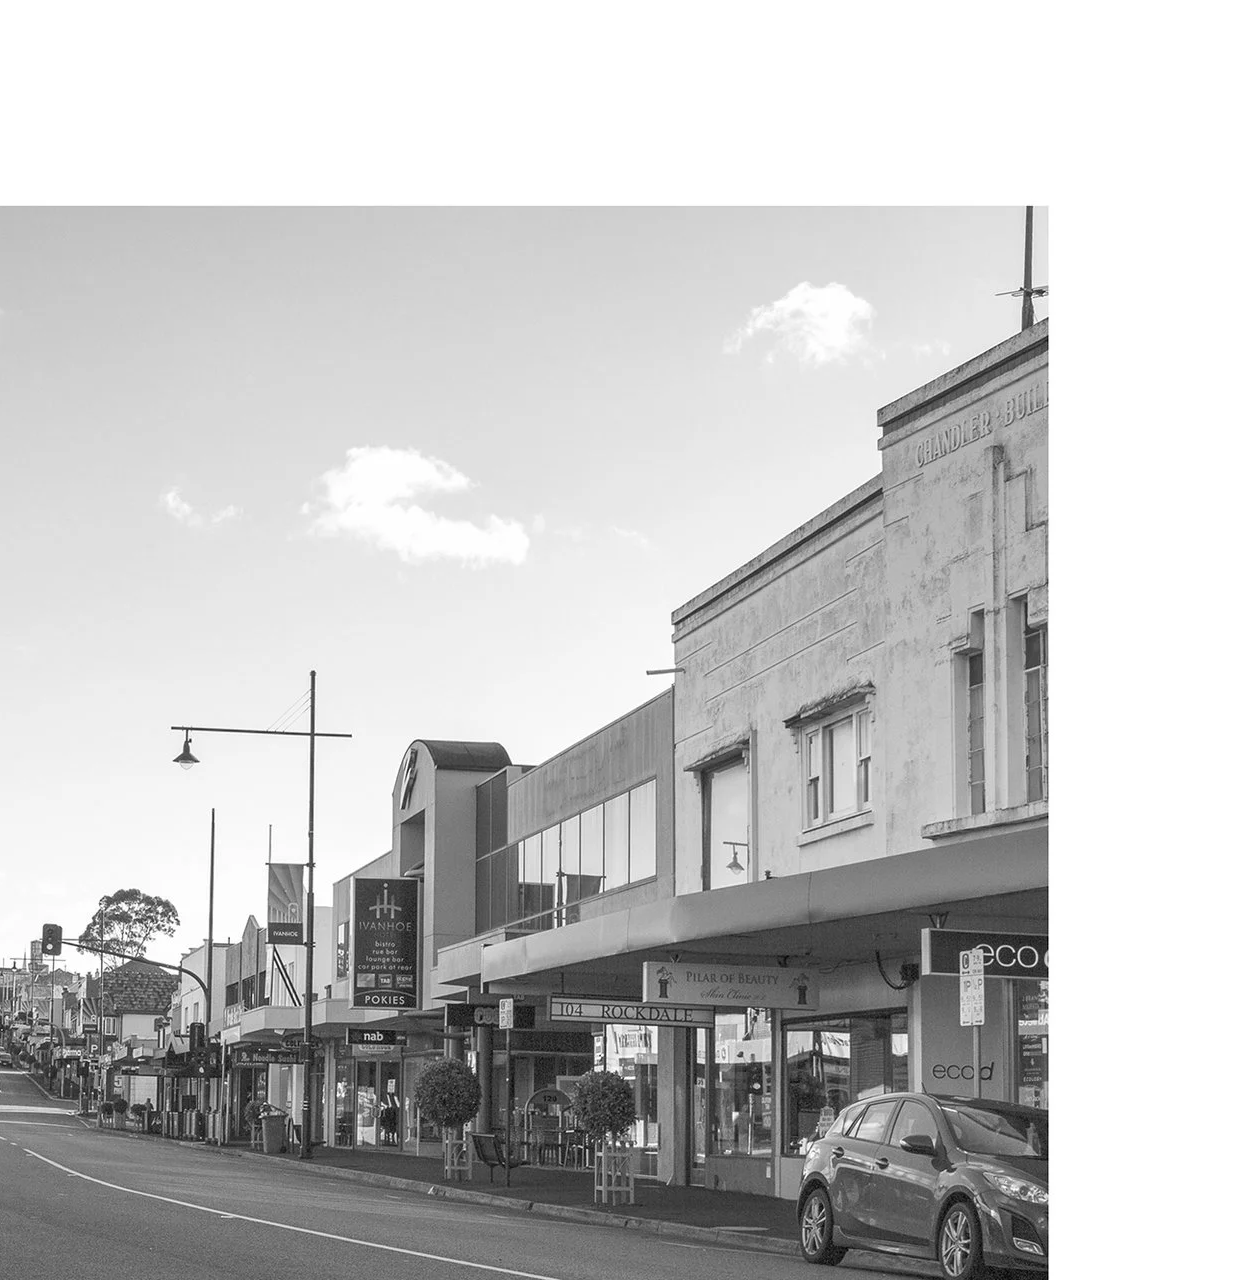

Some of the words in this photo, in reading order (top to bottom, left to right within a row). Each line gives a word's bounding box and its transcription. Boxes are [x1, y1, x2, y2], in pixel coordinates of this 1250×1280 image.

[916, 411, 993, 468] CHANDLER
[1003, 381, 1049, 427] BUIL
[358, 922, 412, 932] IVANHOE
[366, 956, 390, 964] lounge
[685, 971, 716, 984] PILAR
[720, 974, 735, 984] OF
[365, 996, 405, 1004] POKIES
[560, 1003, 584, 1017] 104
[363, 1031, 384, 1041] nab
[252, 1053, 275, 1062] Noodle
[277, 1053, 297, 1062] Sushi
